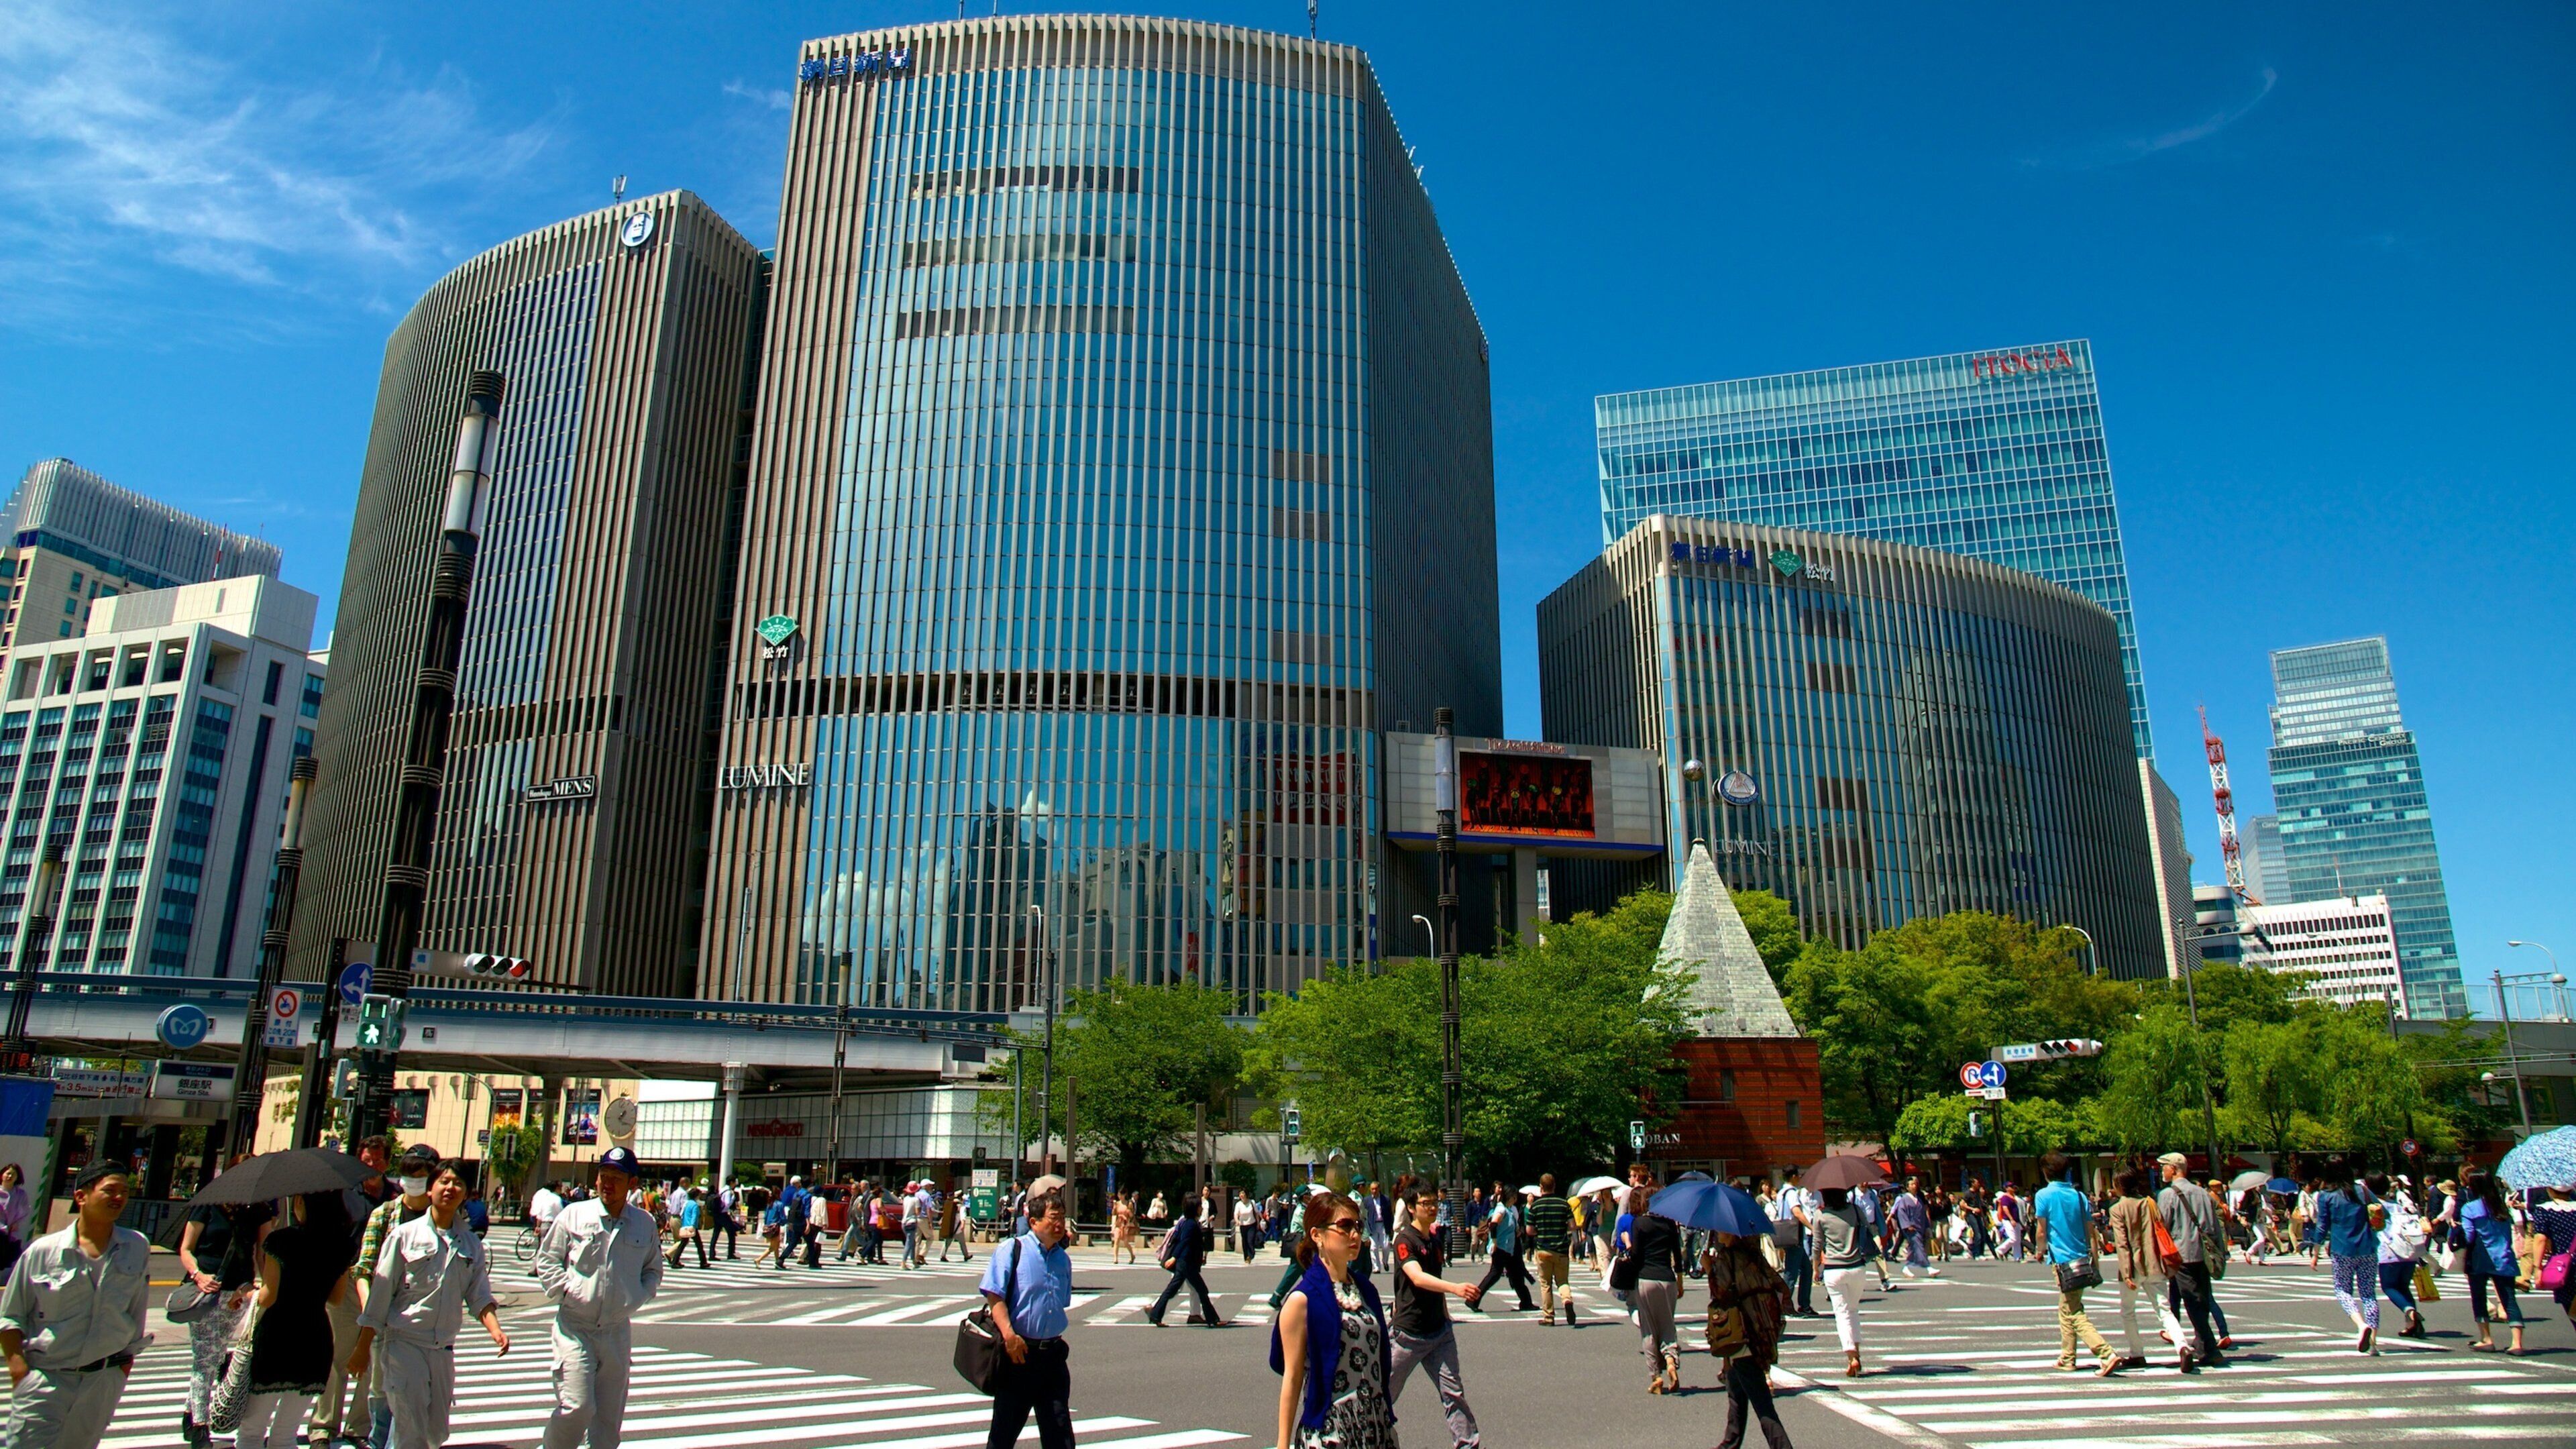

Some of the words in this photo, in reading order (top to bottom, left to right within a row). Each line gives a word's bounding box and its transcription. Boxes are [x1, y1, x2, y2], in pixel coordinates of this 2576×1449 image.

[1803, 562, 1835, 582] 松竹
[762, 646, 789, 659] 松竹
[718, 763, 810, 790] LUMINE
[178, 1078, 213, 1089] 銀座駅
[1646, 1132, 1680, 1144] OBAN
[1397, 1242, 1409, 1260] 6
